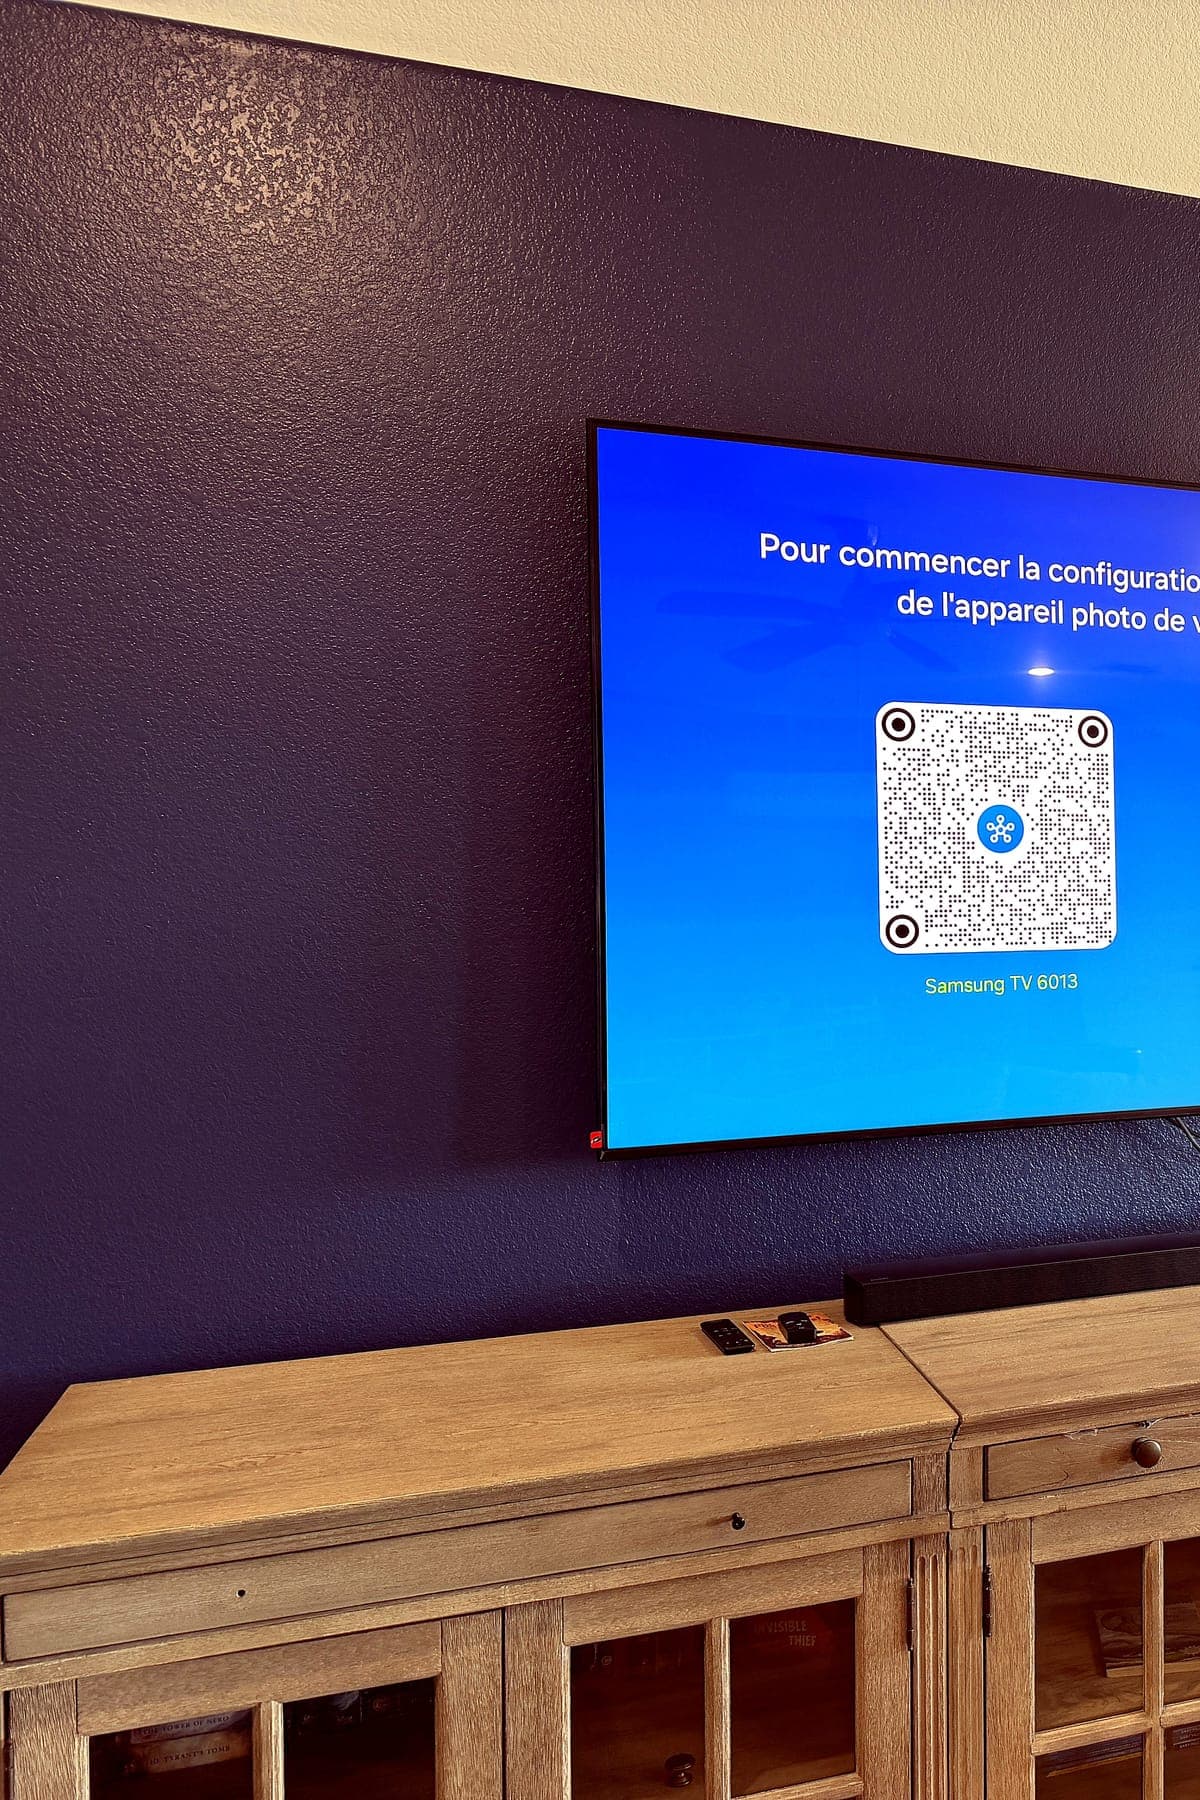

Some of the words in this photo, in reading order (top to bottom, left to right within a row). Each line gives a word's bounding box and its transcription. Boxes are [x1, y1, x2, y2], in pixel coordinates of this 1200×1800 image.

[760, 532, 831, 564] Pour
[839, 546, 1011, 579] commencer
[1018, 554, 1041, 581] la
[897, 589, 934, 616] de
[942, 591, 1064, 627] l'appareil
[1072, 602, 1147, 632] photo
[1153, 607, 1186, 633] de
[925, 978, 1005, 996] Samsung
[1009, 975, 1033, 991] TV
[1037, 973, 1079, 990] 6013
[754, 1620, 808, 1633] INVISIBLE
[788, 1634, 817, 1647] THIEF
[162, 1721, 190, 1732] TOWER
[193, 1717, 203, 1726] OF
[206, 1714, 230, 1724] NERO
[207, 1744, 231, 1755] TOMB
